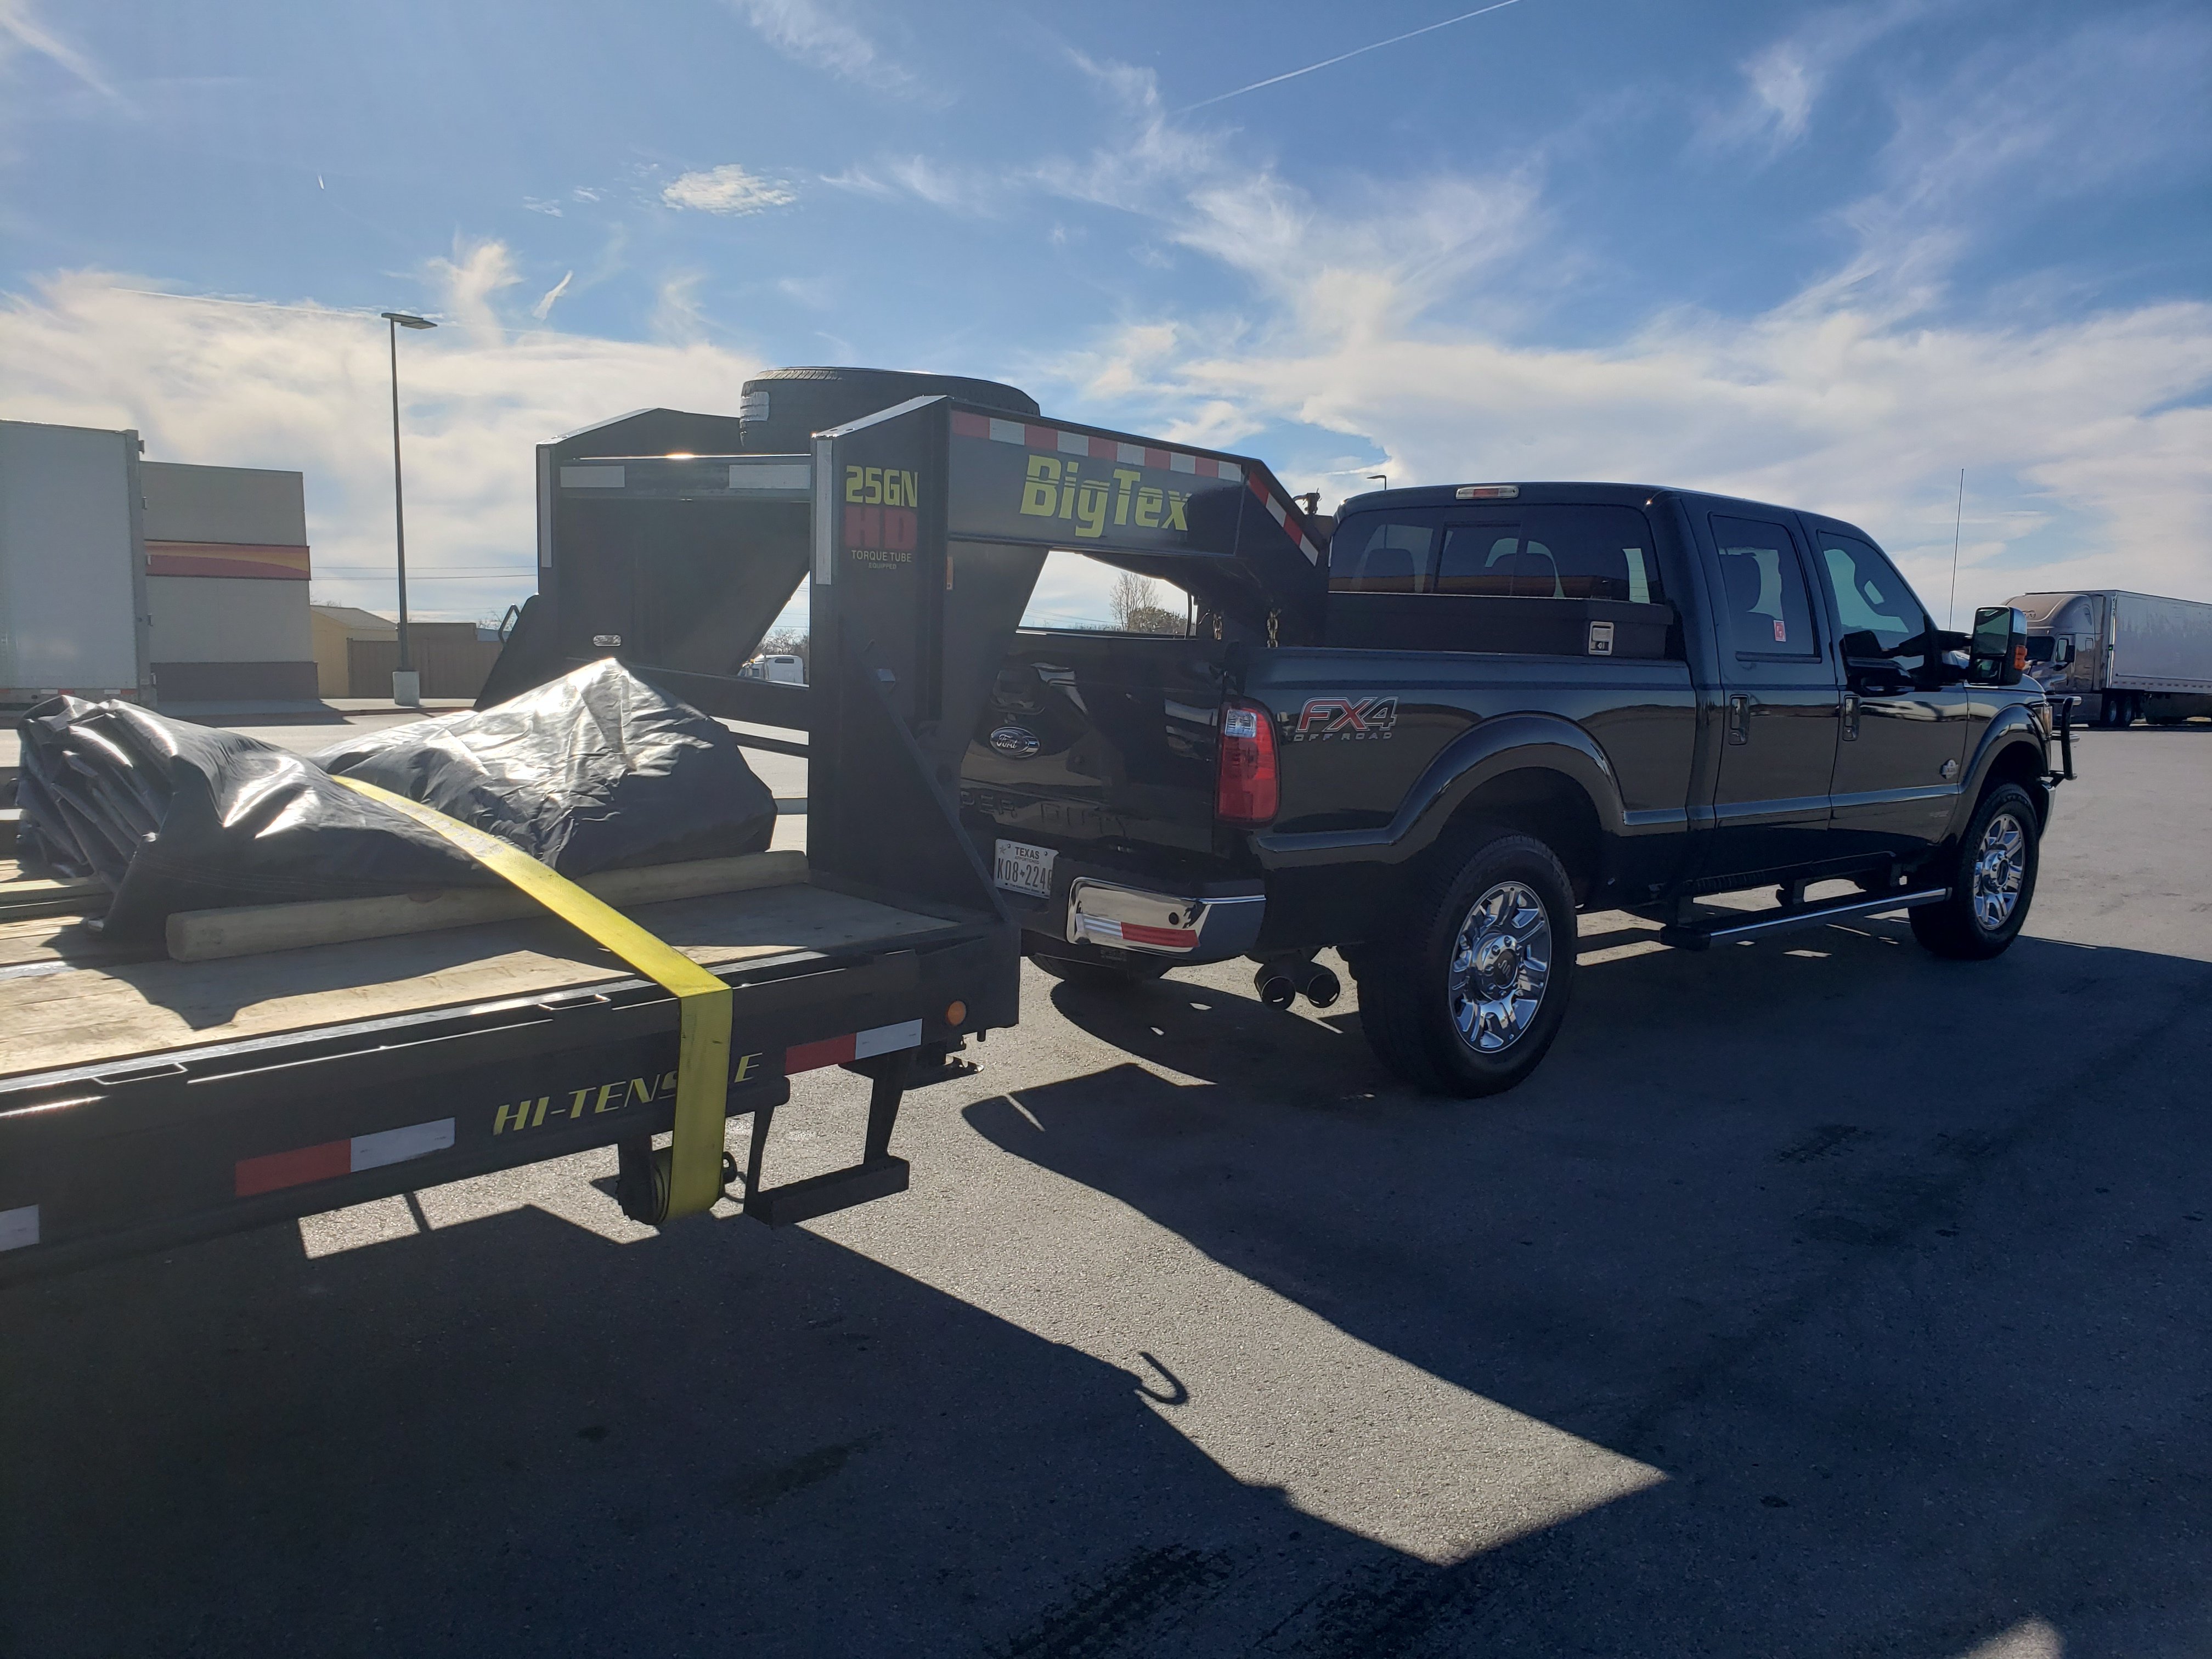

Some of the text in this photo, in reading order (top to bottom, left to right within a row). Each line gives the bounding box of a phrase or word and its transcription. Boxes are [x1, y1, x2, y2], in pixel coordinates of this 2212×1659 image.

[845, 465, 918, 507] 25GN
[845, 506, 917, 550] HD
[851, 550, 912, 562] TORQUE TUBE
[1295, 696, 1399, 733] FX4
[996, 734, 1018, 749] Ford
[1294, 732, 1392, 742] OFF ROAD
[1015, 846, 1040, 860] TEXAS
[997, 857, 1019, 883] K08
[493, 1052, 763, 1136] HI-TENSE
